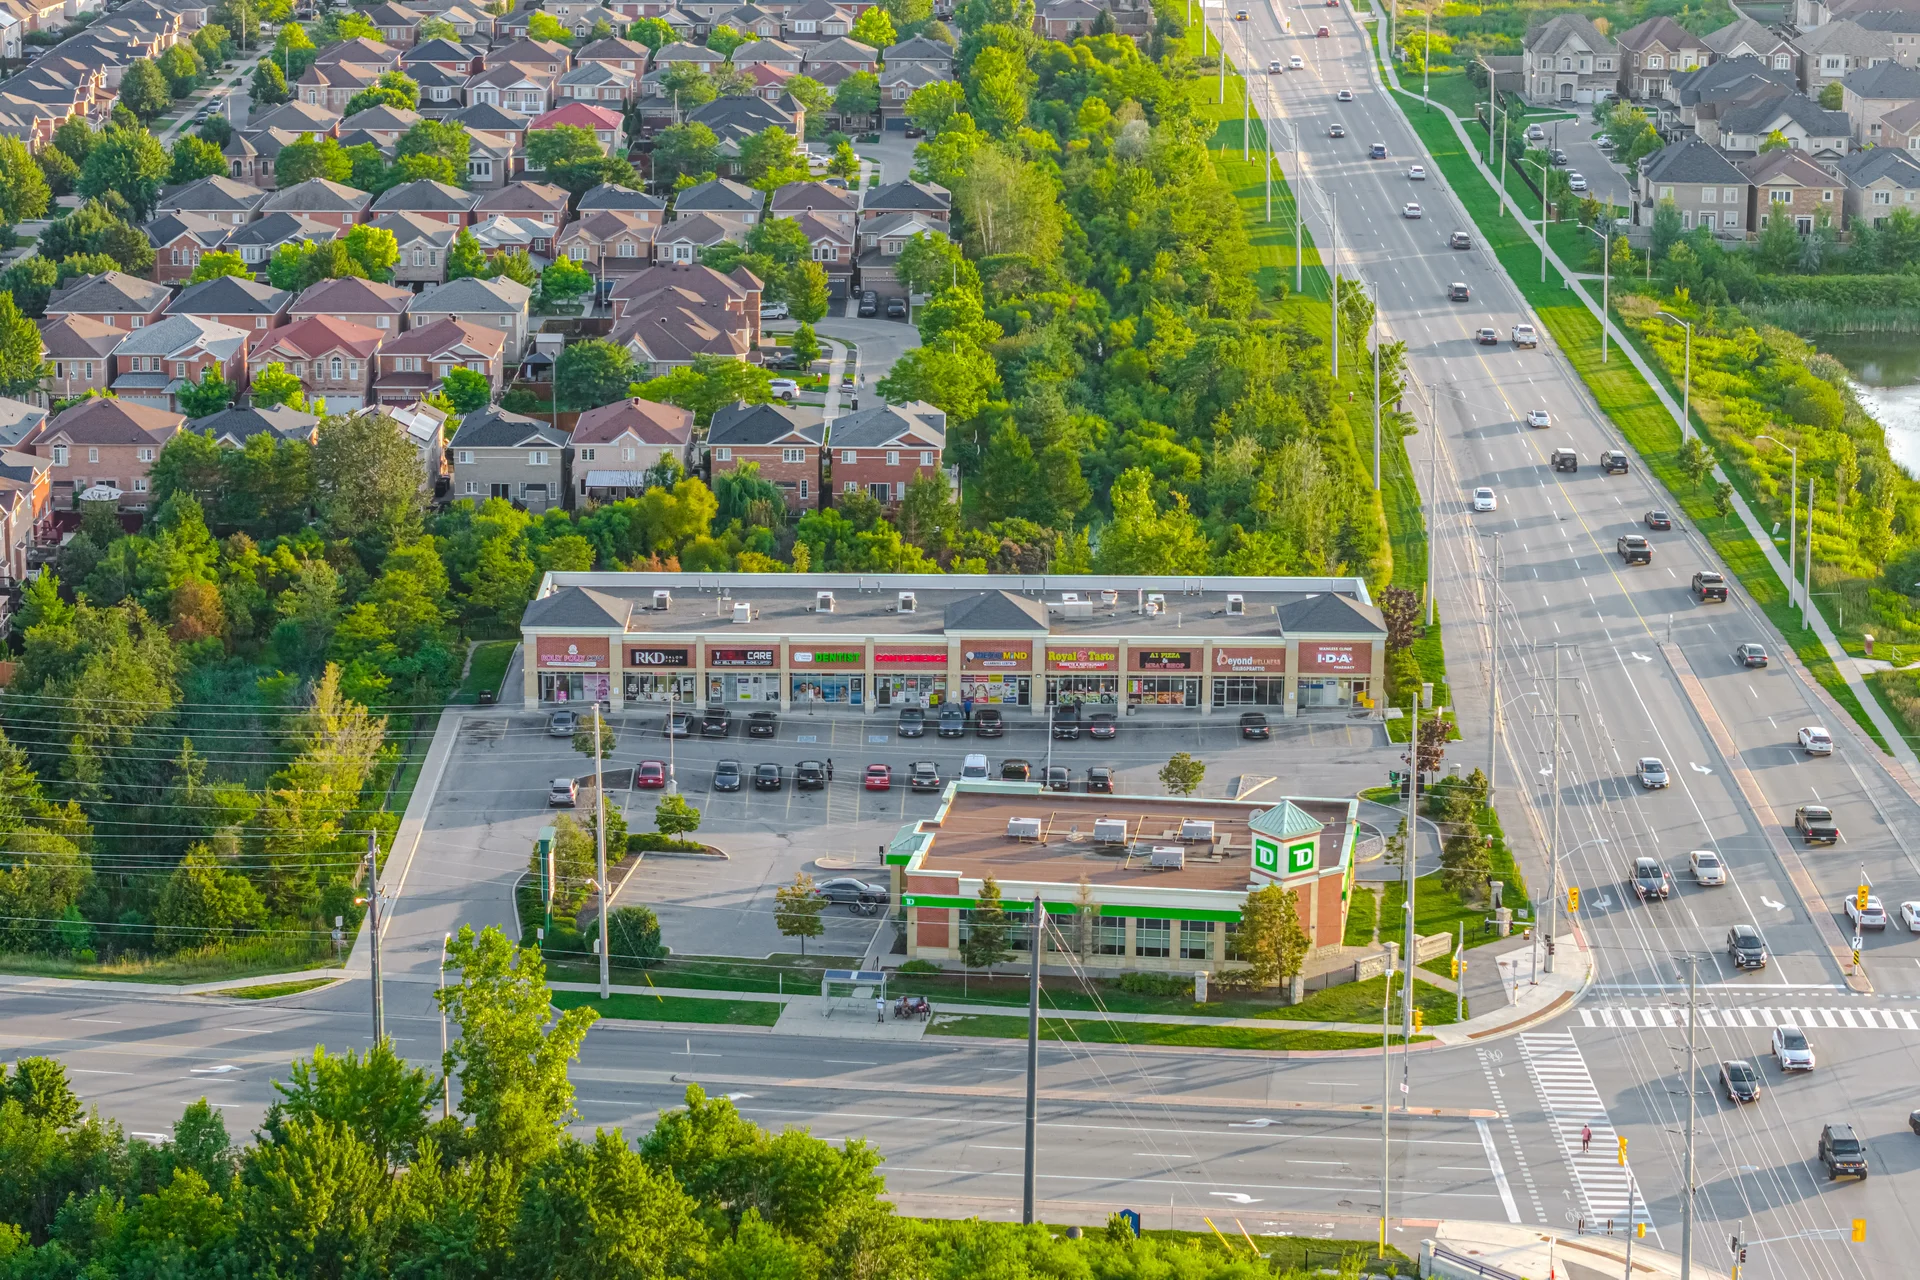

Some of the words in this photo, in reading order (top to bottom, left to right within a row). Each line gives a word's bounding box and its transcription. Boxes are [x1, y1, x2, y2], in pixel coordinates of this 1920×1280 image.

[635, 651, 666, 664] RKD
[747, 651, 772, 660] CARE
[815, 651, 861, 663] DENTIST
[875, 653, 948, 663] CONVENIENCE
[1047, 651, 1077, 662] Royal
[1088, 651, 1115, 661] Taste
[1256, 844, 1275, 866] TD
[1292, 847, 1313, 867] TD
[905, 897, 915, 906] TD
